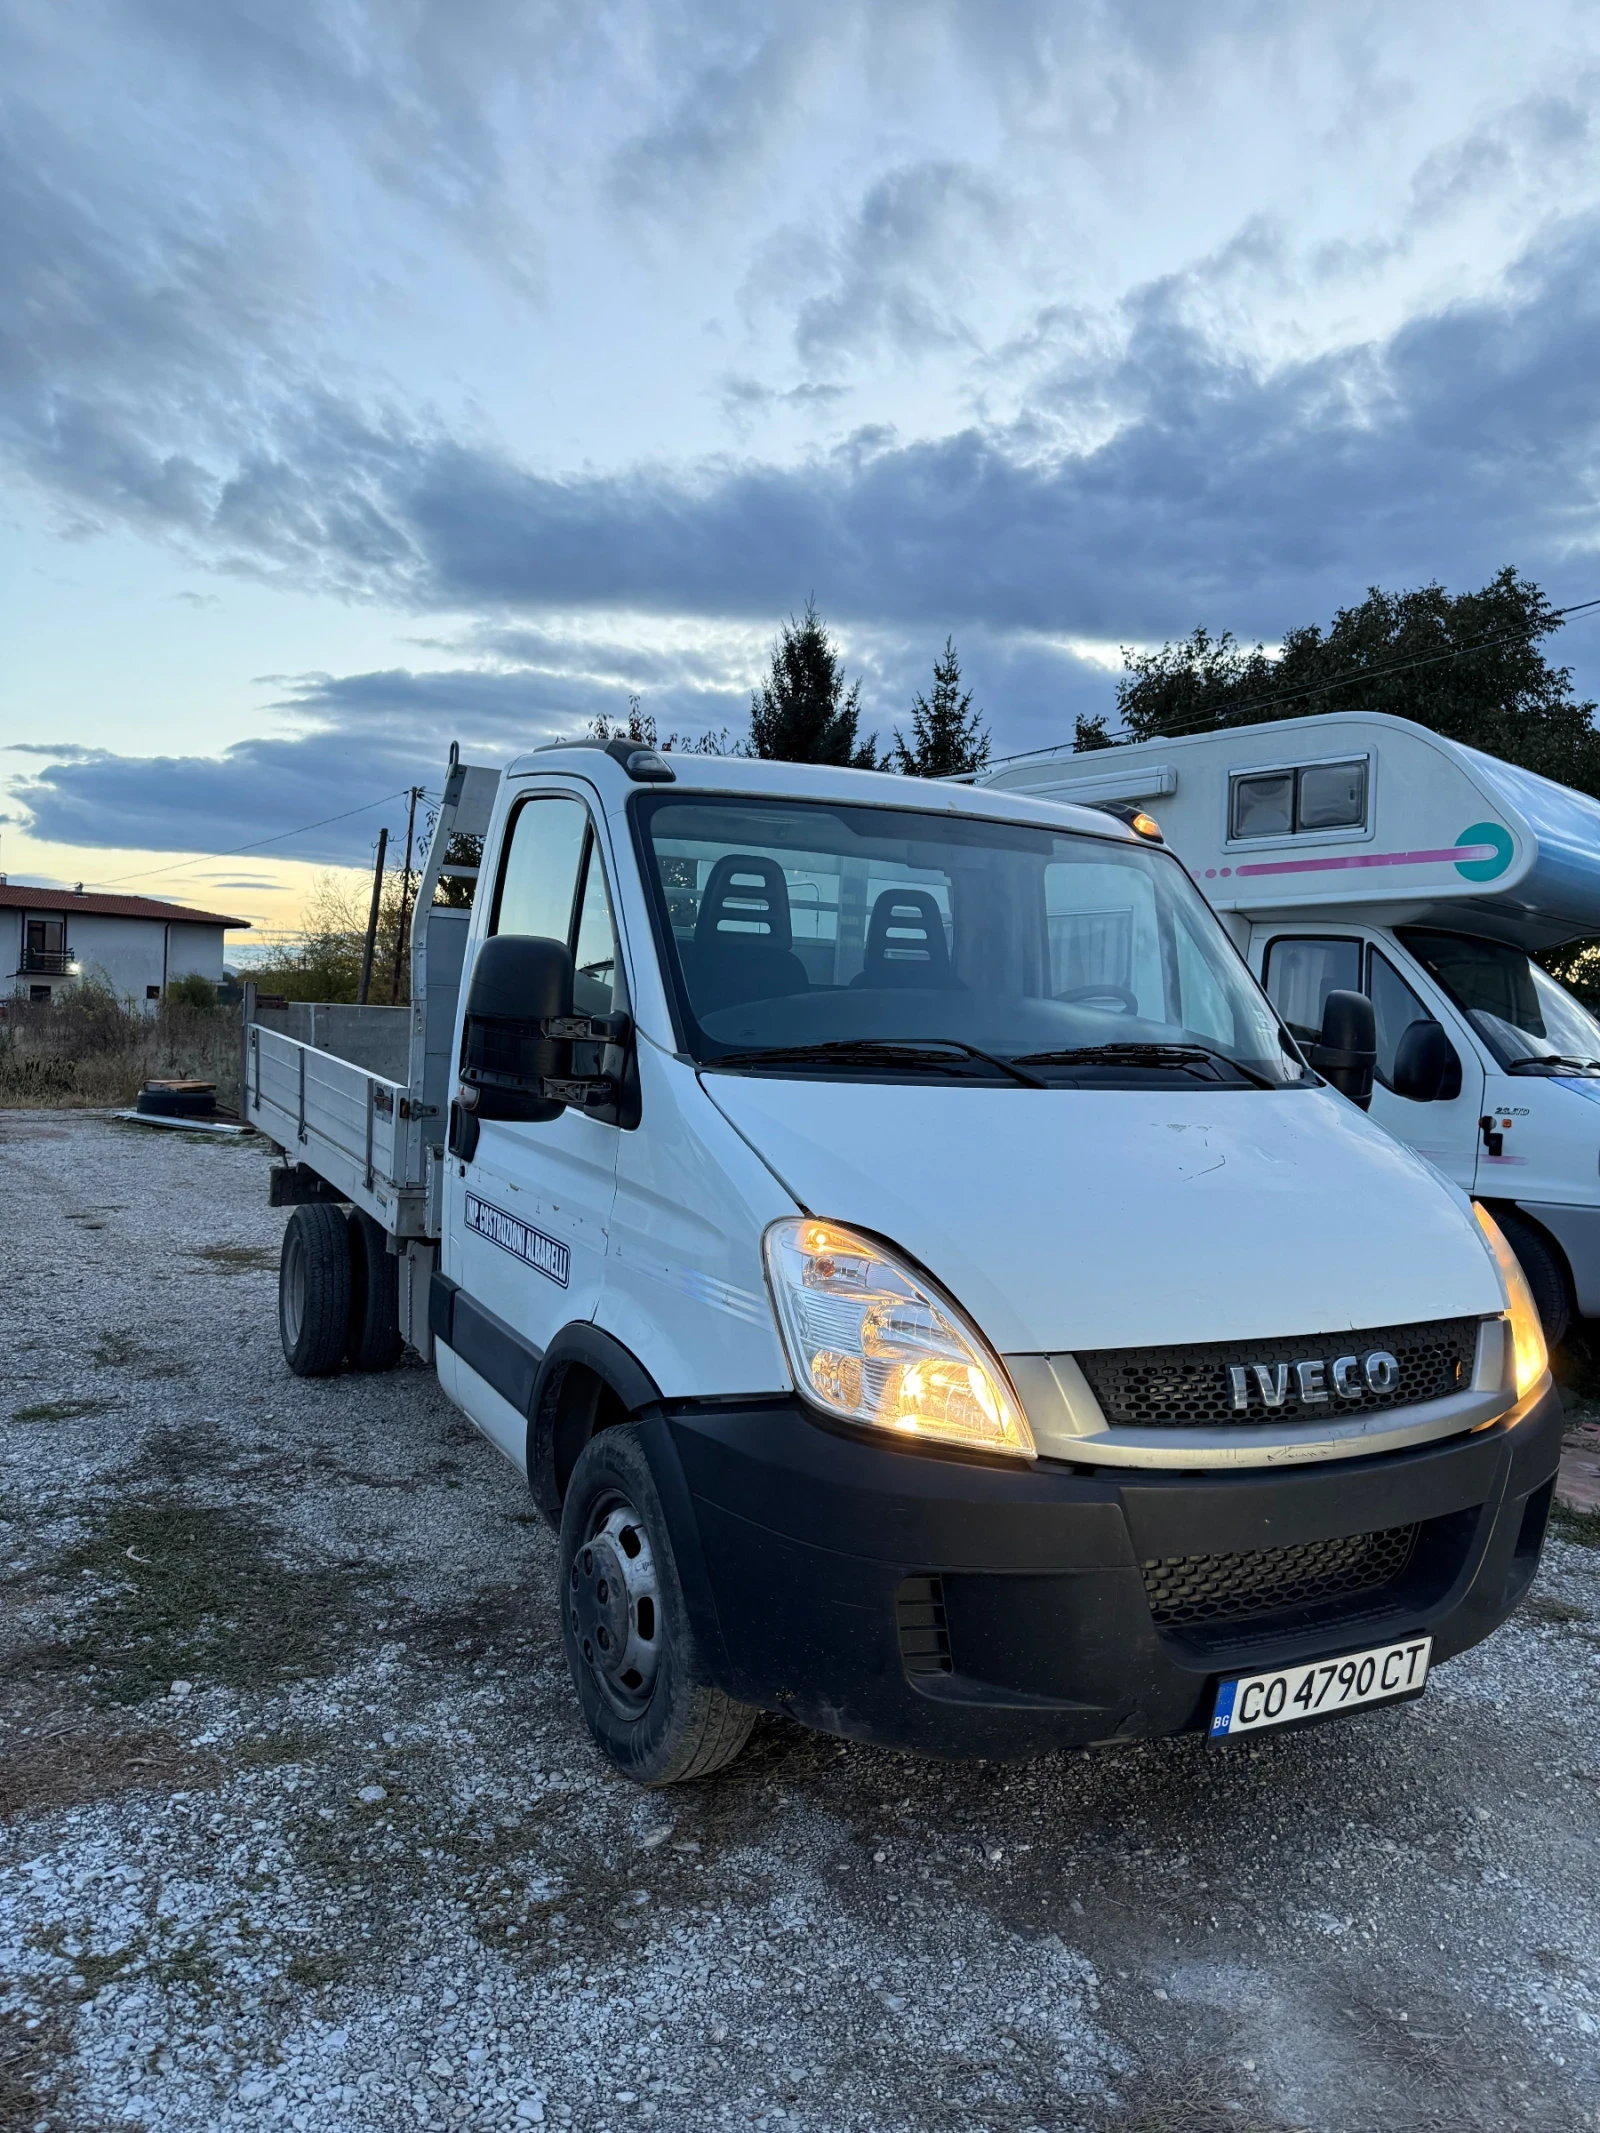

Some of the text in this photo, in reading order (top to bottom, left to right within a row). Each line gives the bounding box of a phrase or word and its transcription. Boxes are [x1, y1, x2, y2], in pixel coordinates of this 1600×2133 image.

[480, 1203, 526, 1257] COSTRUZIONI
[525, 1229, 568, 1283] ALBARELLI
[1228, 1351, 1400, 1409] IVECO
[1239, 1643, 1426, 1724] CO 4790 CT
[1213, 1714, 1230, 1730] BG
